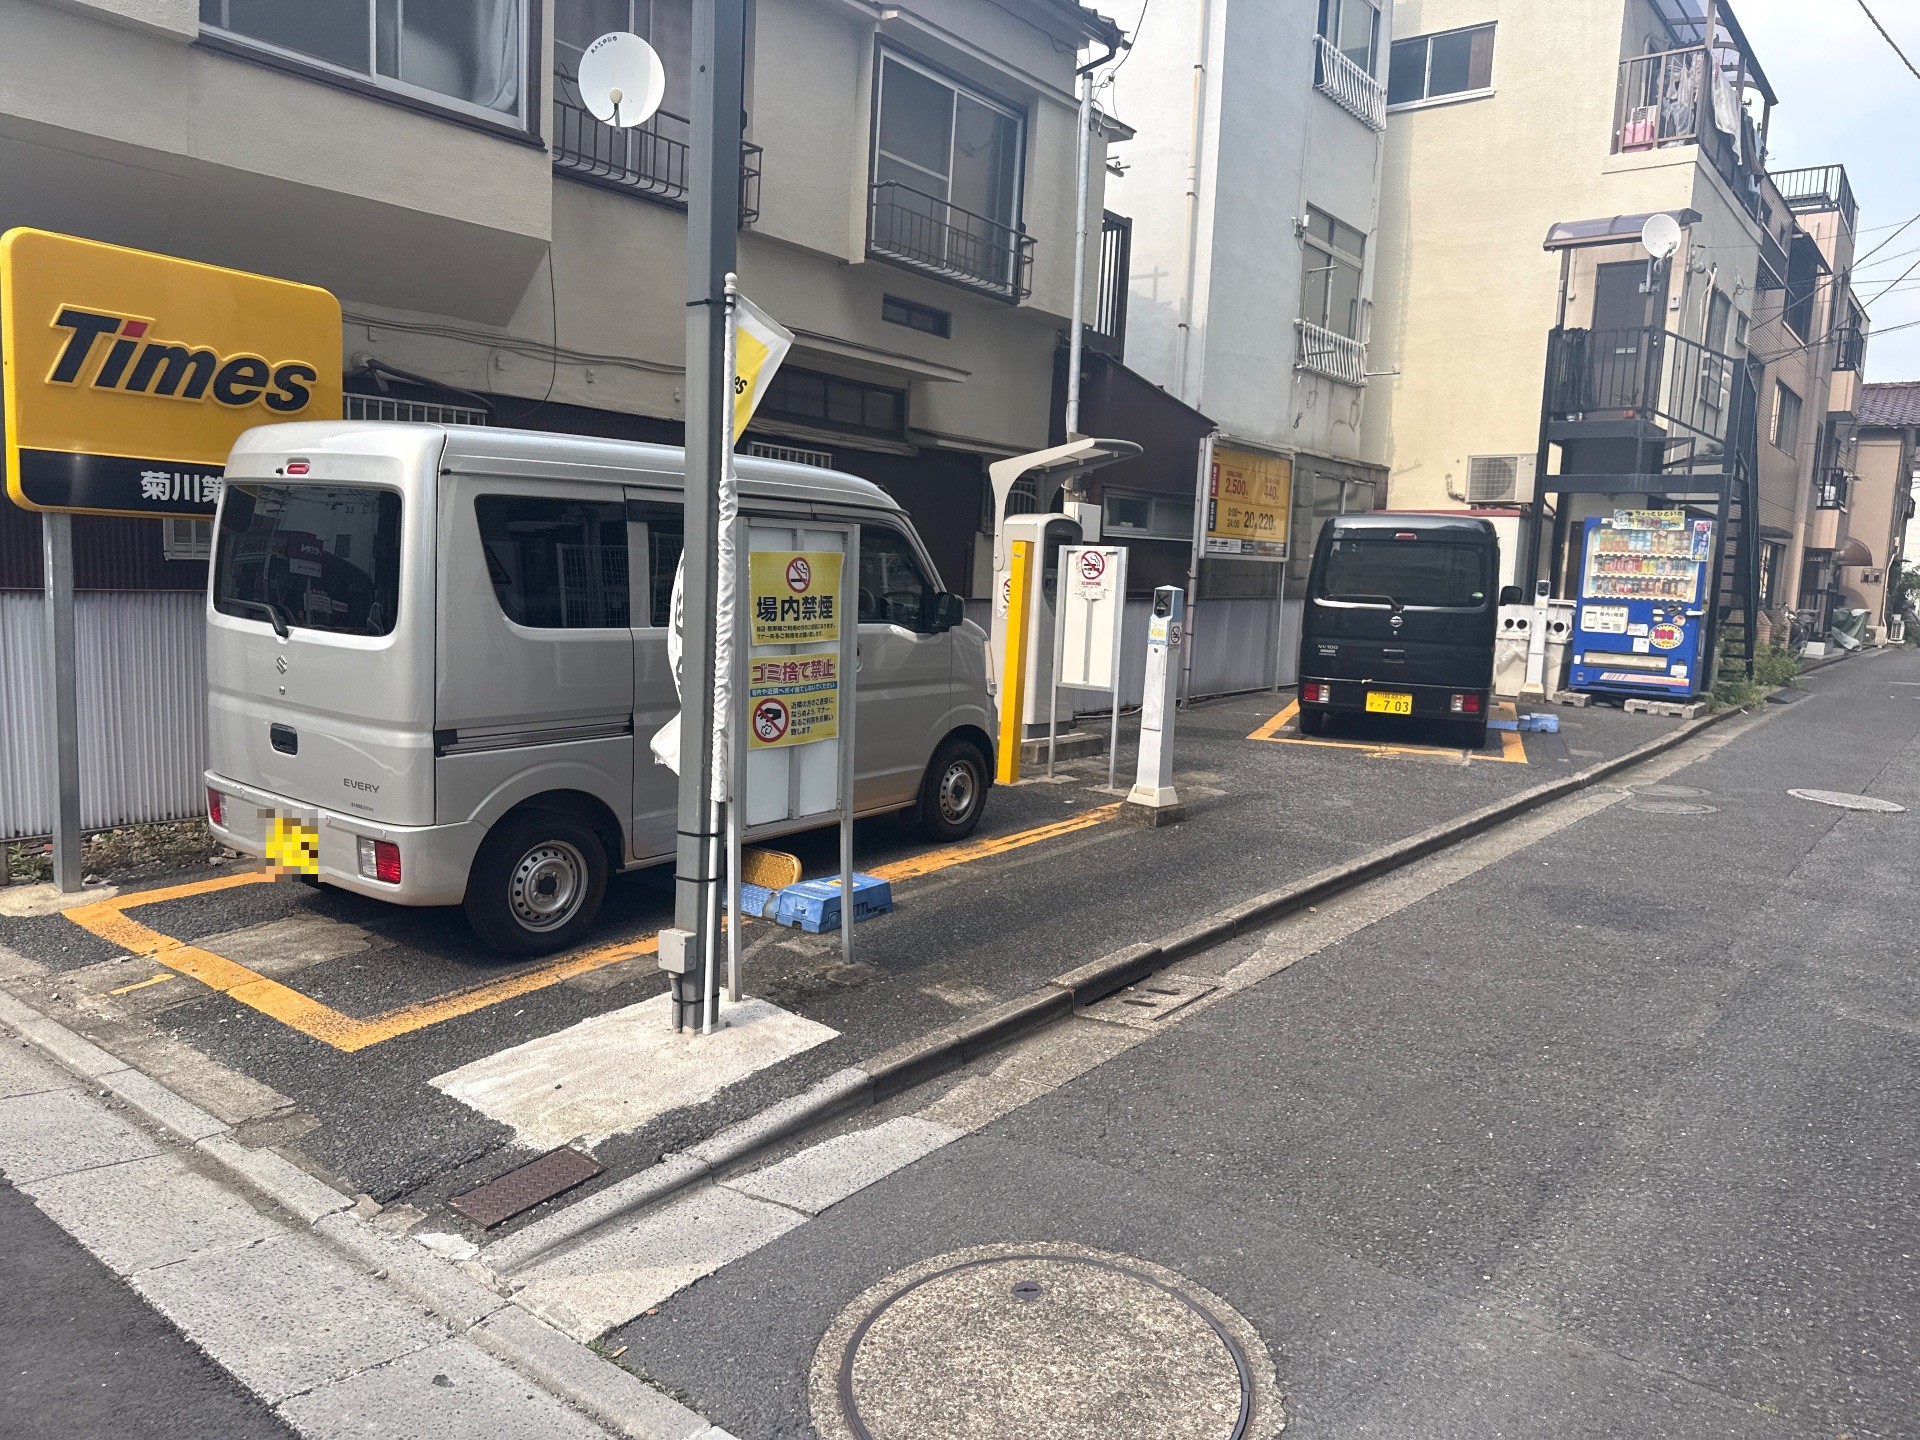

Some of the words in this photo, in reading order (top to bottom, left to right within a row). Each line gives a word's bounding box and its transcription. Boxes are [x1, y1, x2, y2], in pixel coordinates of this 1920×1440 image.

[49, 309, 317, 411] Times
[757, 595, 833, 622] 場内禁煙
[752, 658, 836, 684] ゴミ捨て禁止
[343, 778, 380, 793] EVERY
